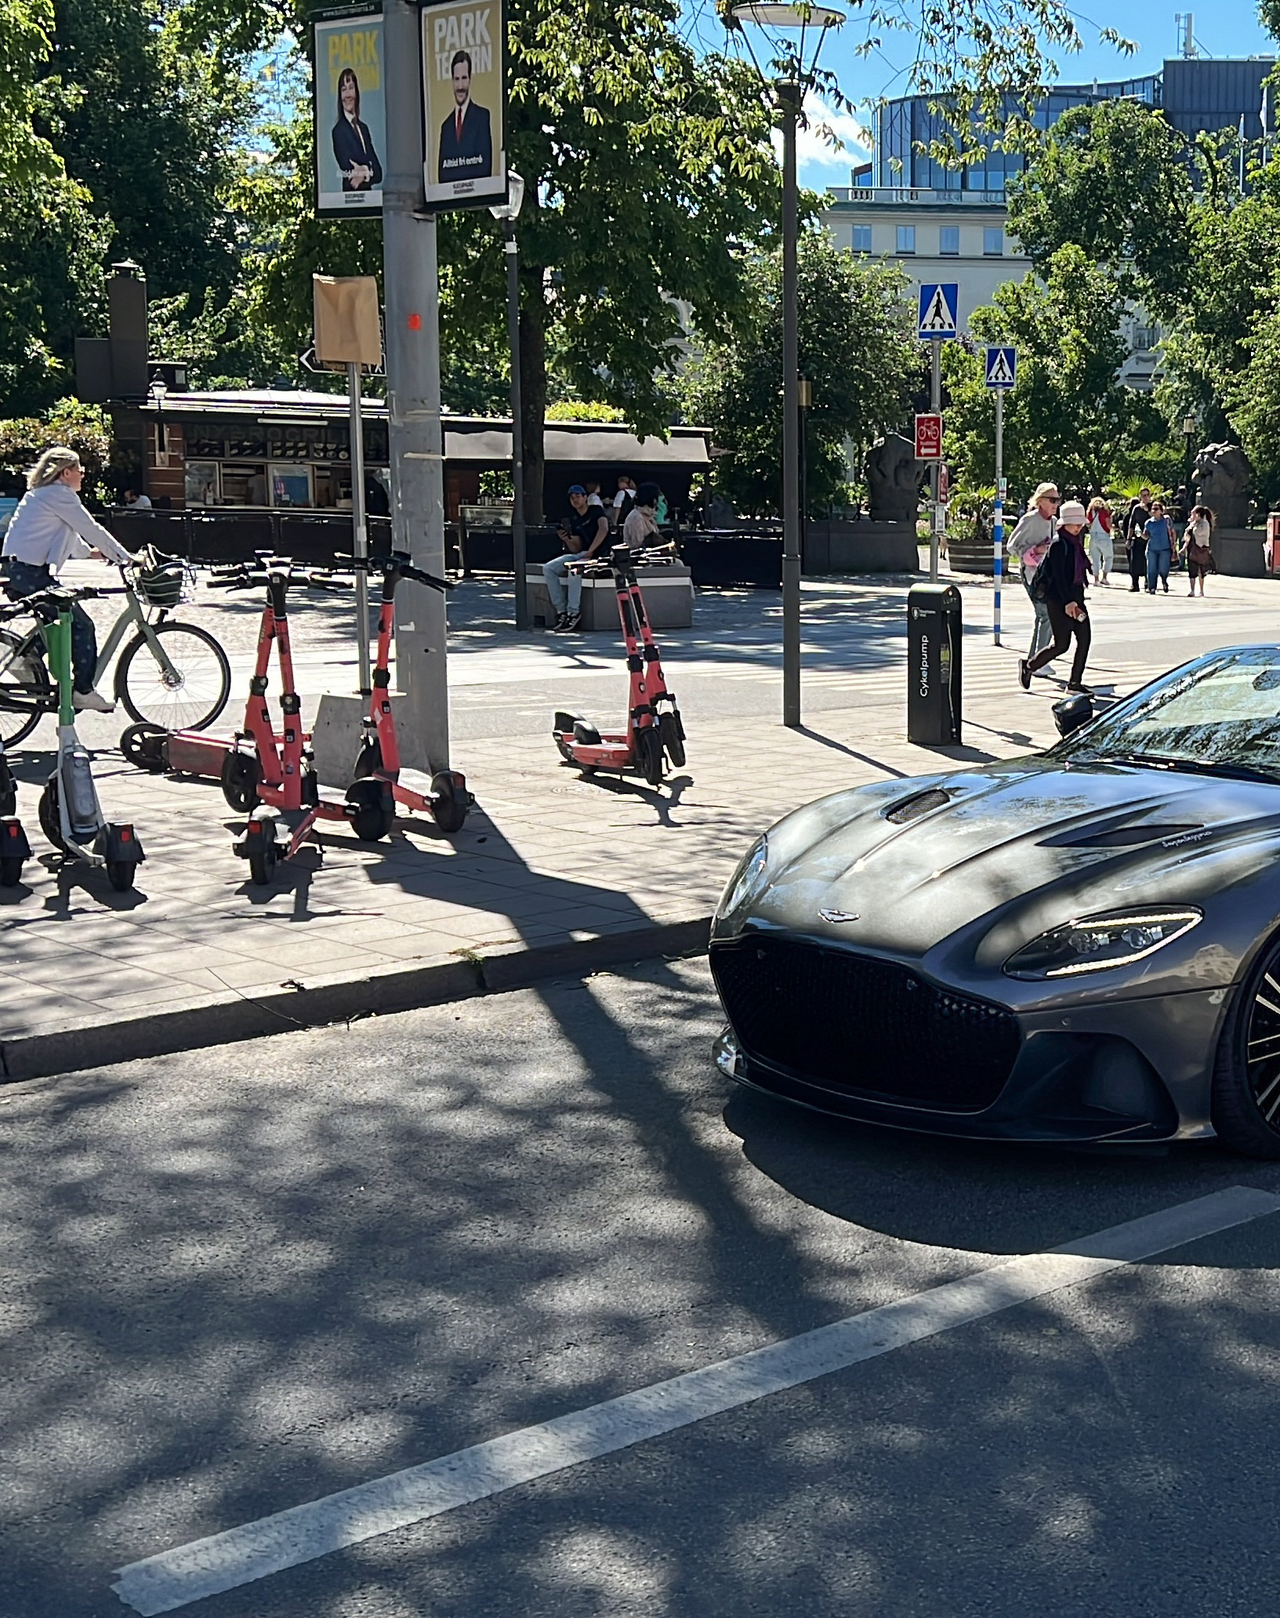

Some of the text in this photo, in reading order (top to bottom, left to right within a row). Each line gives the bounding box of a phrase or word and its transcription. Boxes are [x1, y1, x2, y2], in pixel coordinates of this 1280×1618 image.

[328, 30, 379, 68] PARK
[434, 8, 491, 53] PARK
[435, 43, 493, 81] TERN
[920, 635, 930, 697] Cykelpump
